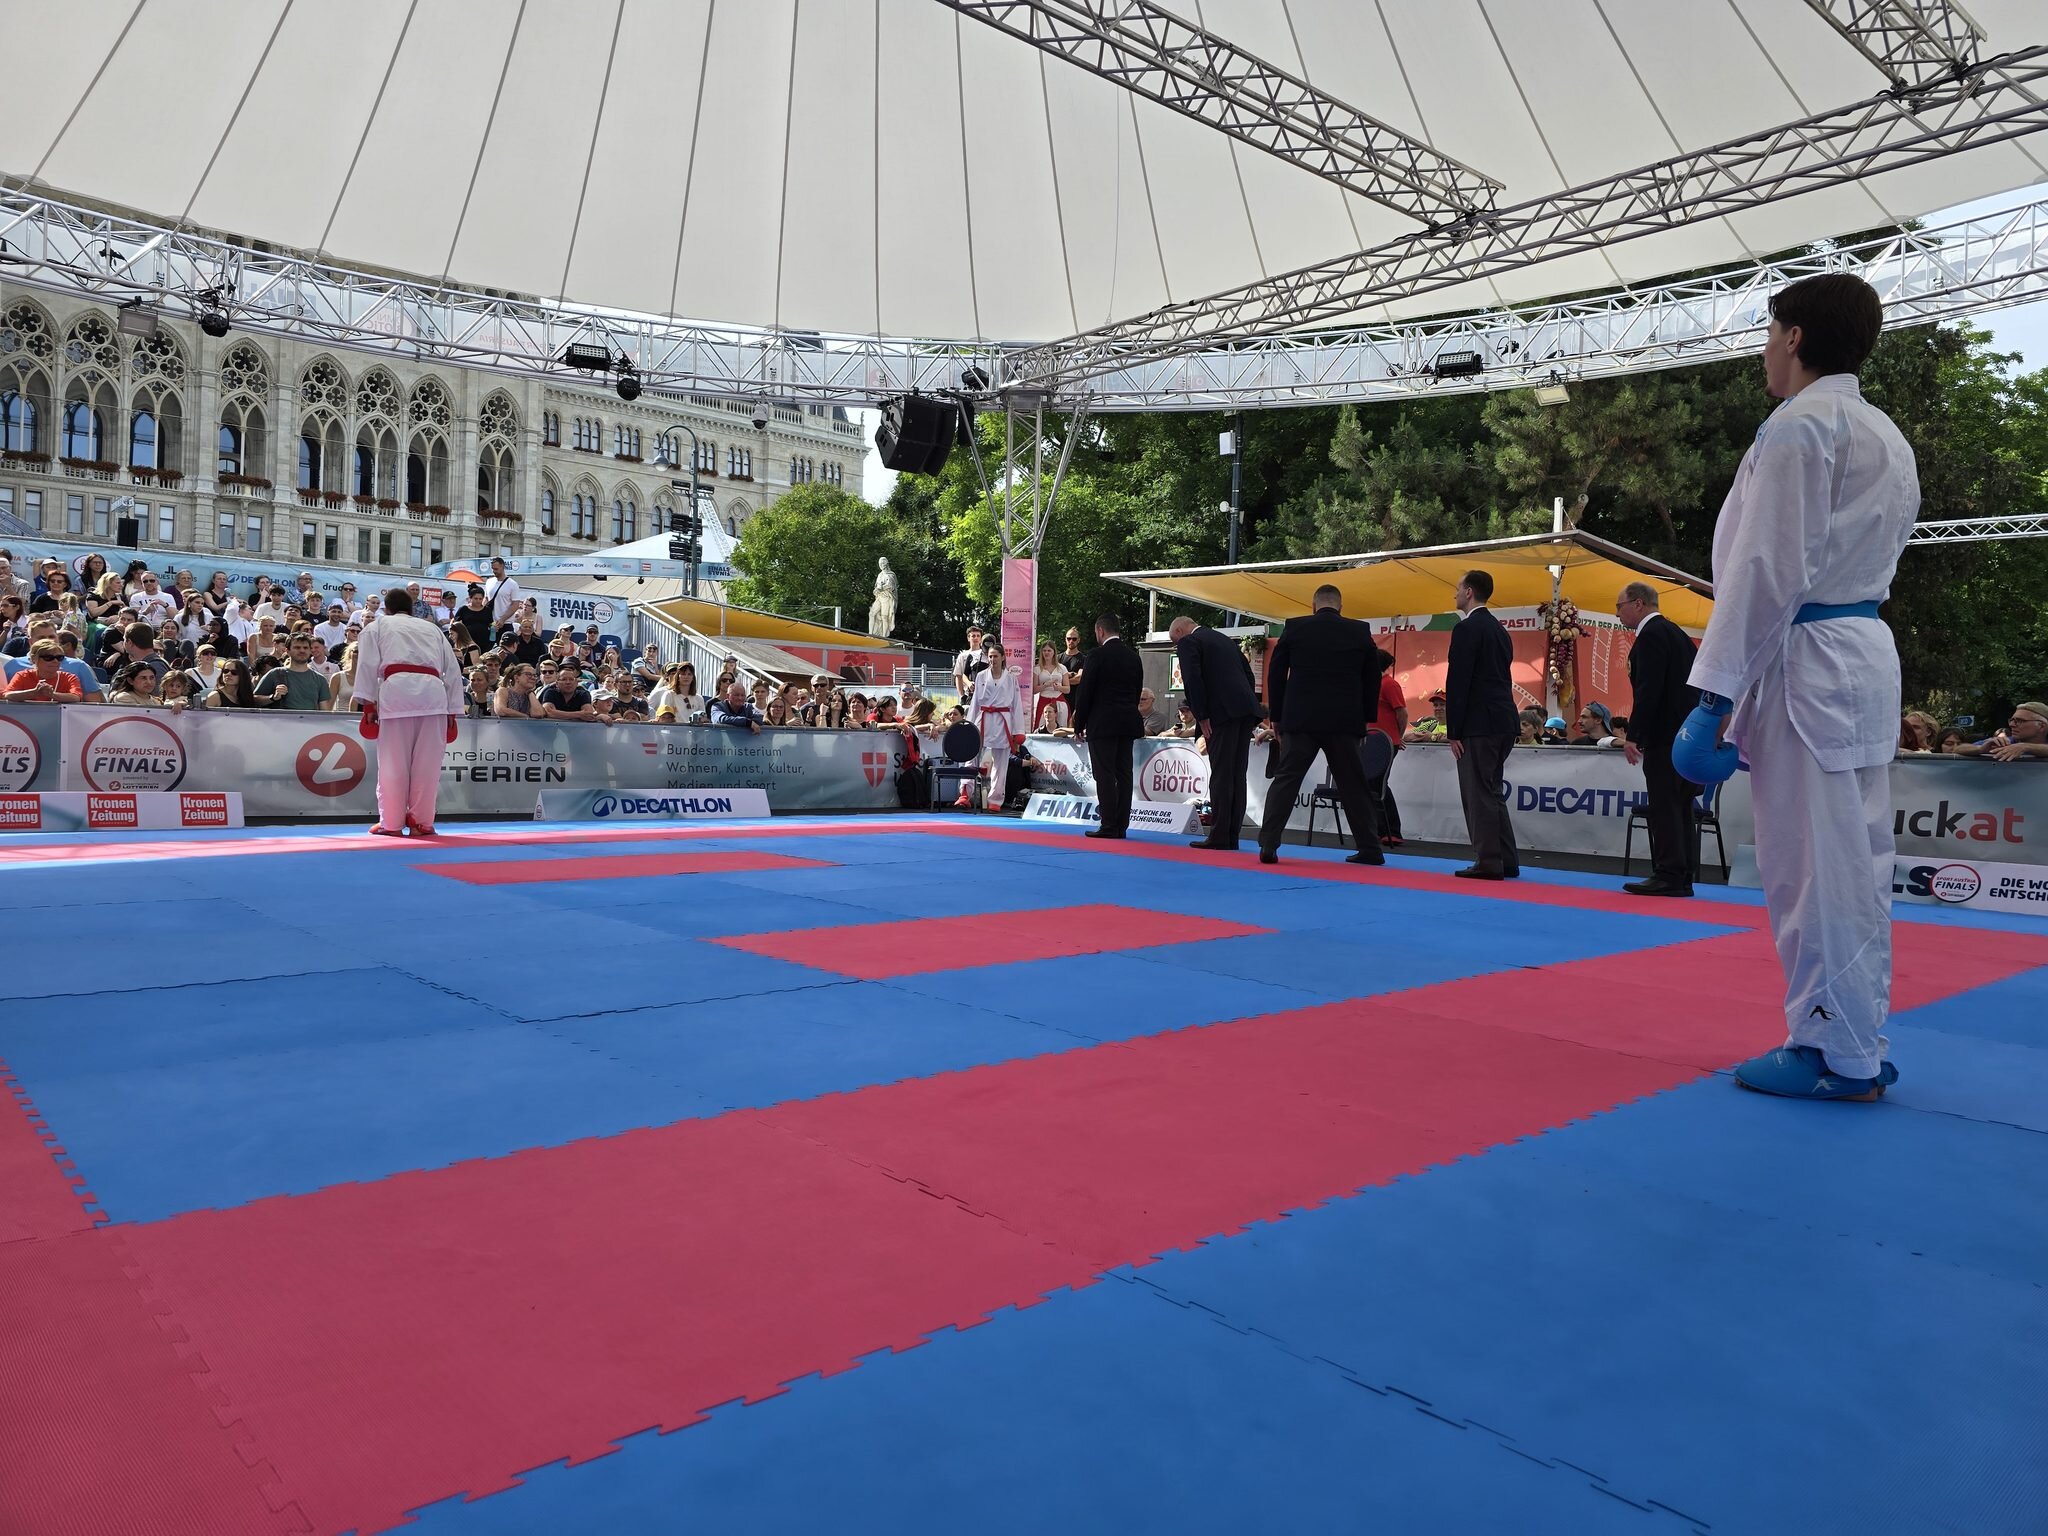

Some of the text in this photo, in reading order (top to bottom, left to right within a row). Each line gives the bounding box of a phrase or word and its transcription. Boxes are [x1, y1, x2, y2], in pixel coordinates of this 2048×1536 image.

[551, 598, 595, 611] FINALS
[94, 747, 175, 756] SPORT AUSTRIA
[667, 744, 782, 757] Bundesministerium
[93, 757, 177, 773] FINALS
[666, 762, 805, 776] Wohnen, Kunst, Kultur,
[90, 798, 134, 808] Kronen
[183, 797, 224, 808] Kronen
[621, 797, 732, 815] DECATHLON
[91, 810, 135, 822] Zeitung
[184, 809, 225, 821] Zeitung
[1139, 809, 1159, 817] WOCHE
[1935, 881, 1975, 891] FINALS
[2000, 878, 2025, 888] DIE
[1990, 888, 2048, 901] ENTSCH
